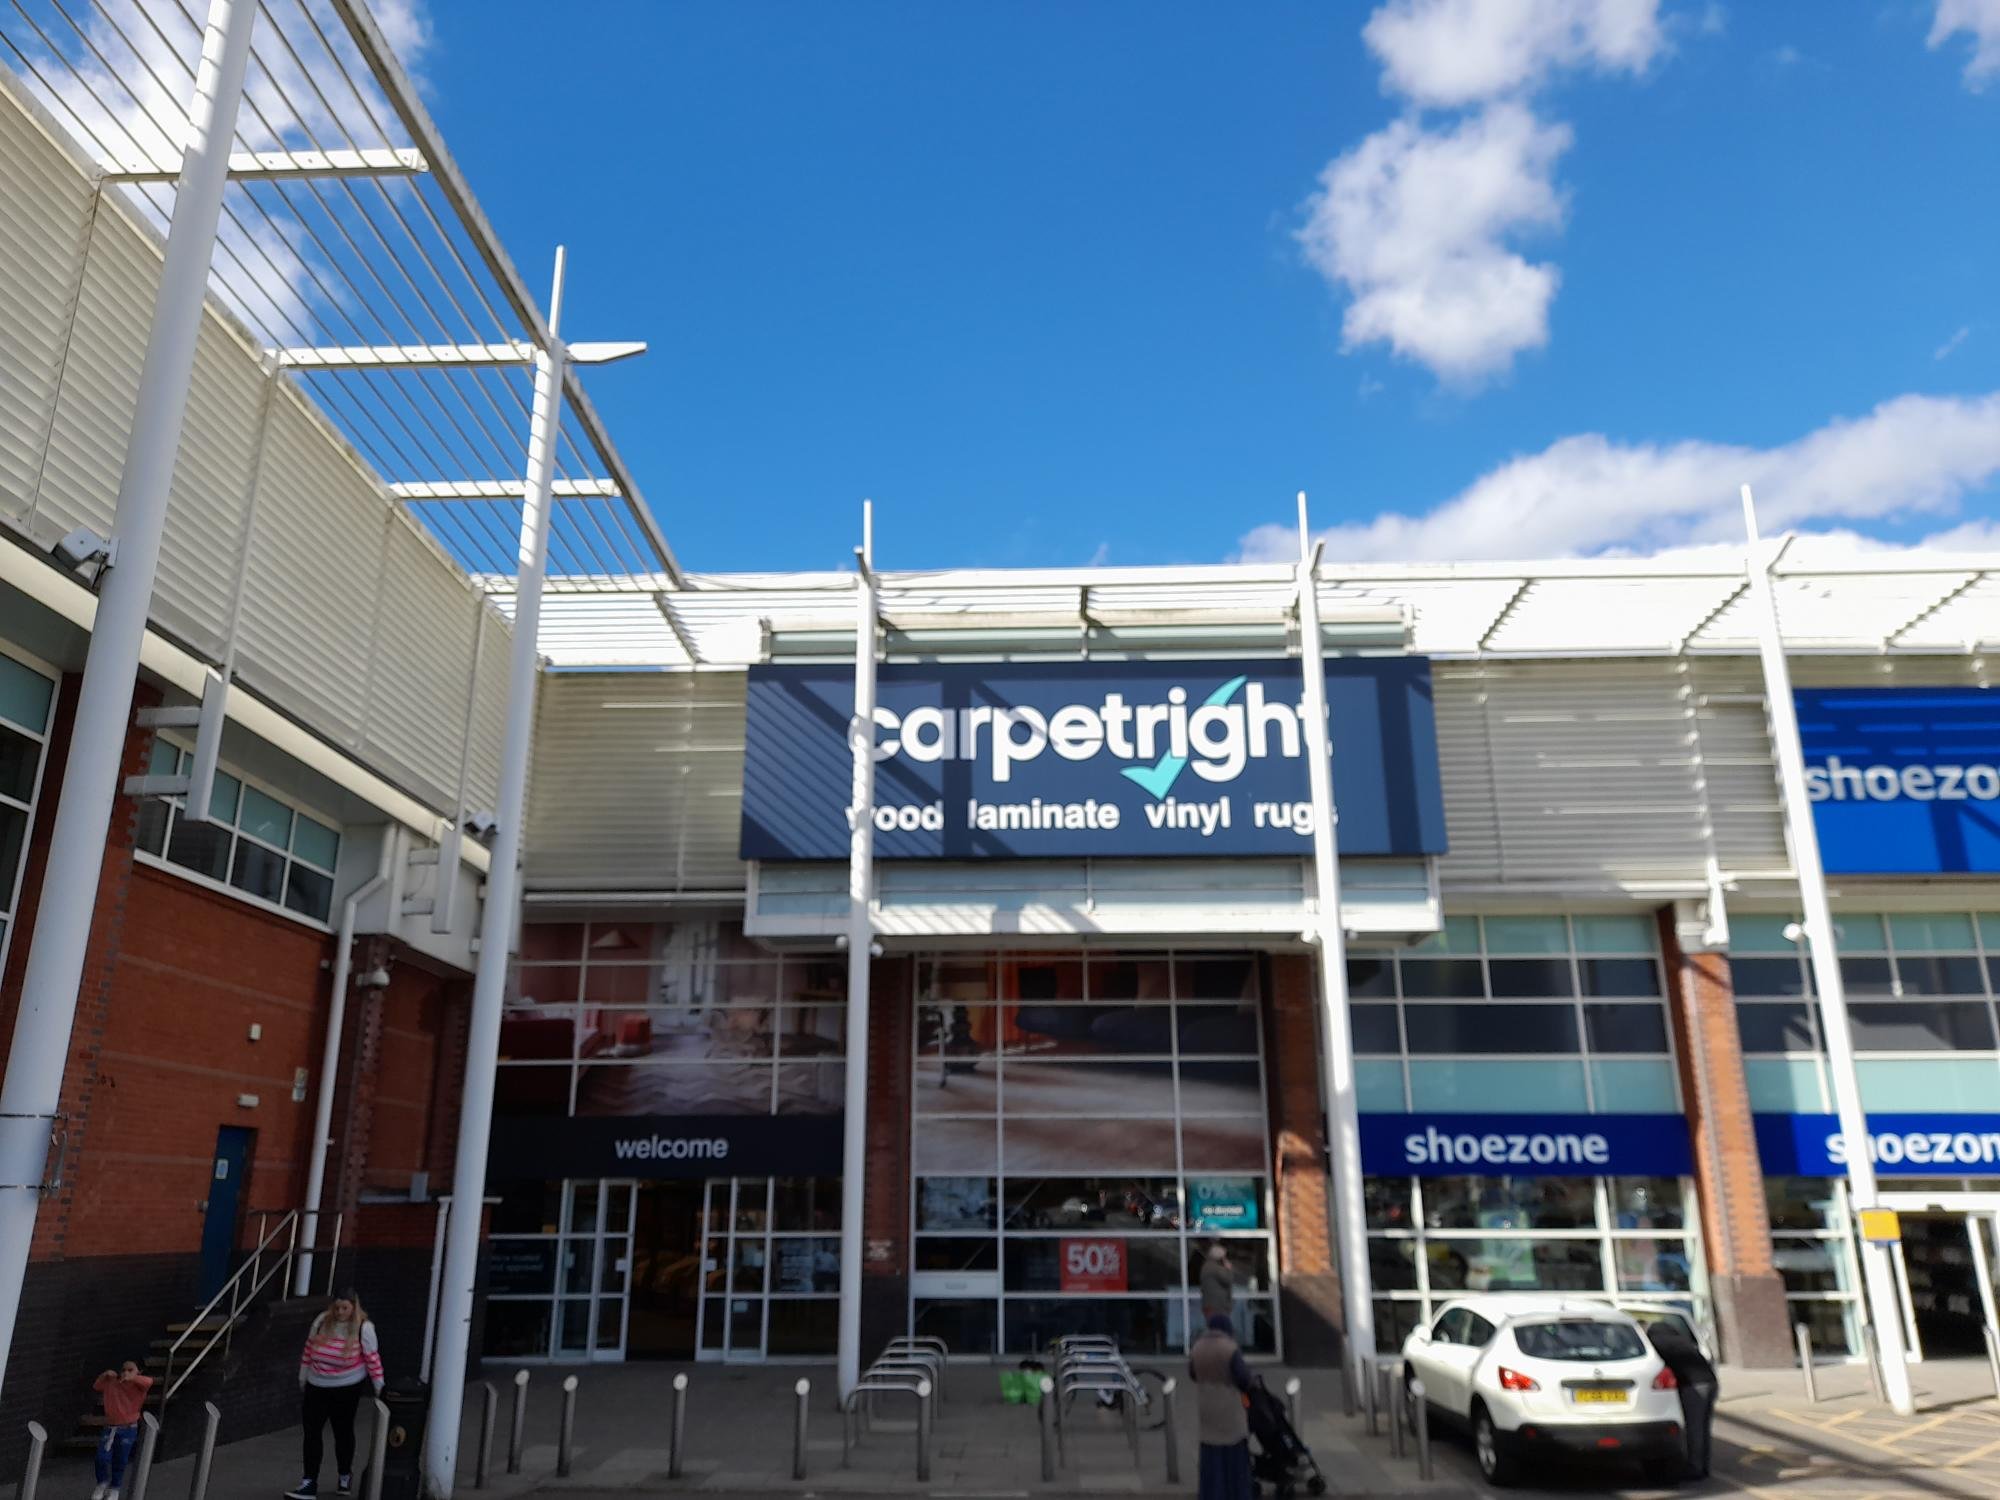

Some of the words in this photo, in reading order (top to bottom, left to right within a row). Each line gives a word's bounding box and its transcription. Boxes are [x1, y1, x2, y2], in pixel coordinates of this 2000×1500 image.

[1802, 756, 2000, 801] shoezo
[968, 799, 1120, 831] laminate
[1144, 796, 1231, 837] vinyl
[1253, 801, 1339, 836] rug
[615, 1134, 729, 1159] welcome
[1405, 1126, 1609, 1164] shoezone
